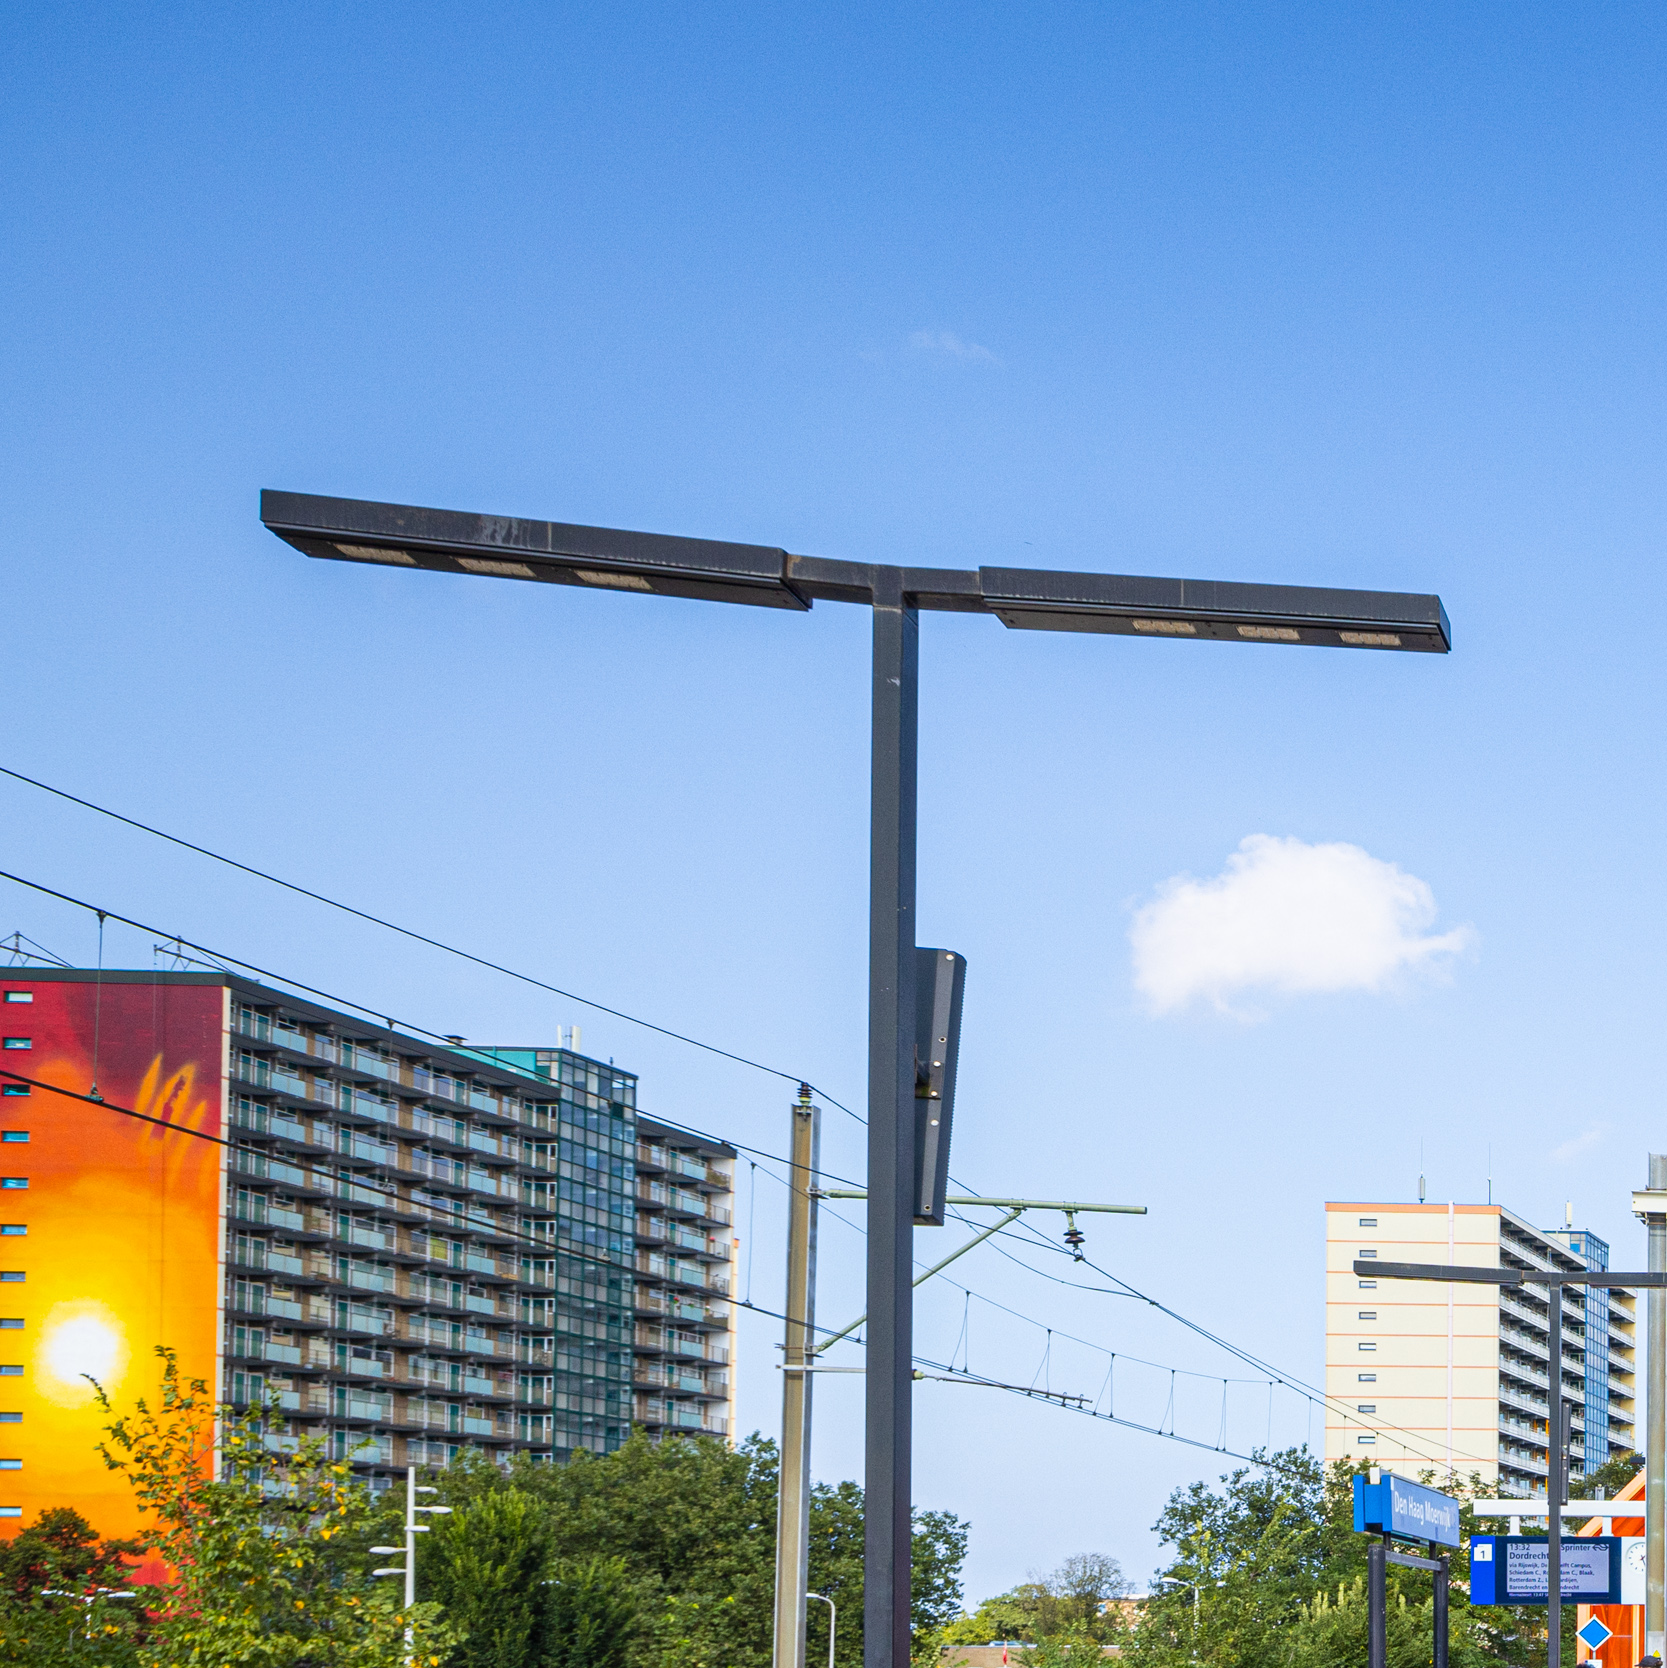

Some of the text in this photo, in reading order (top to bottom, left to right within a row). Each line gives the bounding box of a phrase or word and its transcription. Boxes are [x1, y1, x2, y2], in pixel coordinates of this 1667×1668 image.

[1395, 1491, 1407, 1515] Den
[1409, 1496, 1424, 1525] Haag
[1560, 1544, 1591, 1552] Sprinter
[1480, 1551, 1485, 1559] 1
[1509, 1551, 1550, 1560] Dordrecht
